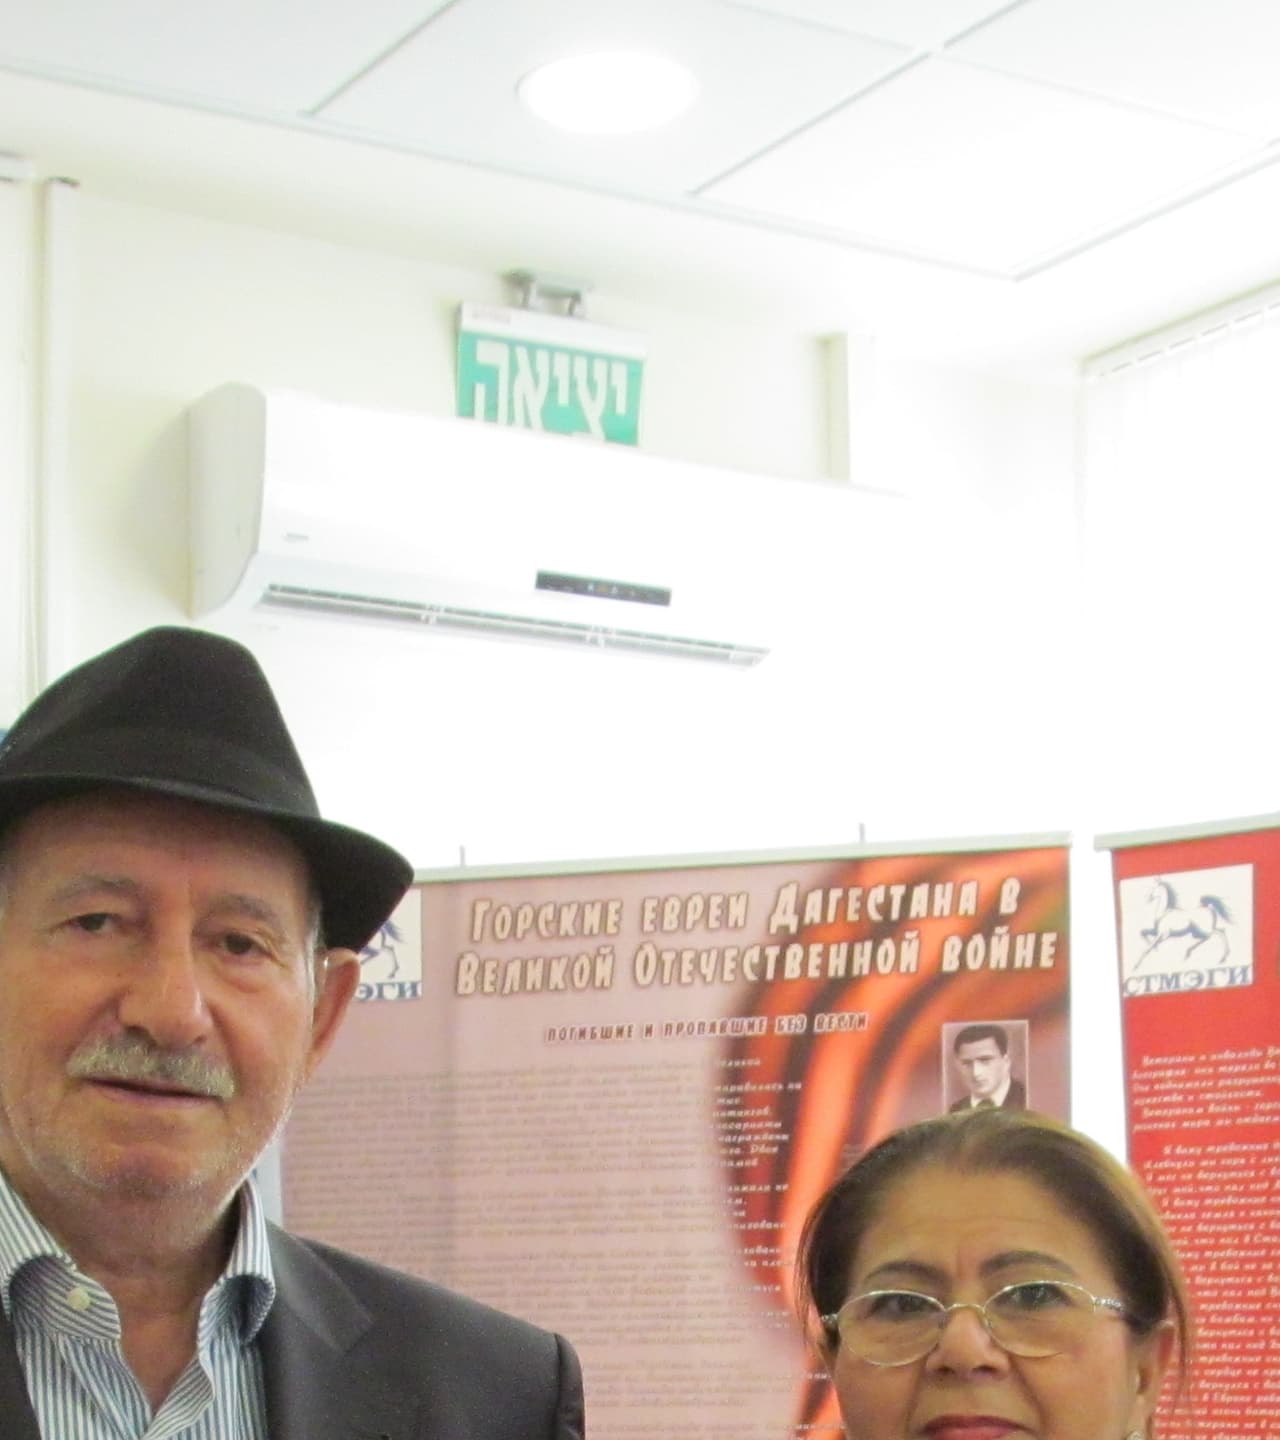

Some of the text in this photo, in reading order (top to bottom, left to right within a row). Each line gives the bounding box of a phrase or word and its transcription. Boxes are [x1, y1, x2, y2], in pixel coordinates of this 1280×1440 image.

[474, 339, 628, 440] יציאה
[472, 877, 1023, 942] ГОРСКИЕ ЕВРЕИ ДАГЕСТАНА В
[456, 925, 1059, 997] ВЕЛИКОЙ ОТЕЧЕСТВЕННОЙ ВОЙНЕ
[1122, 963, 1252, 997] СТМЭГИ
[358, 982, 422, 1002] ЭГИ
[546, 1019, 636, 1044] ПОГИБШИЕ
[643, 1021, 656, 1040] И
